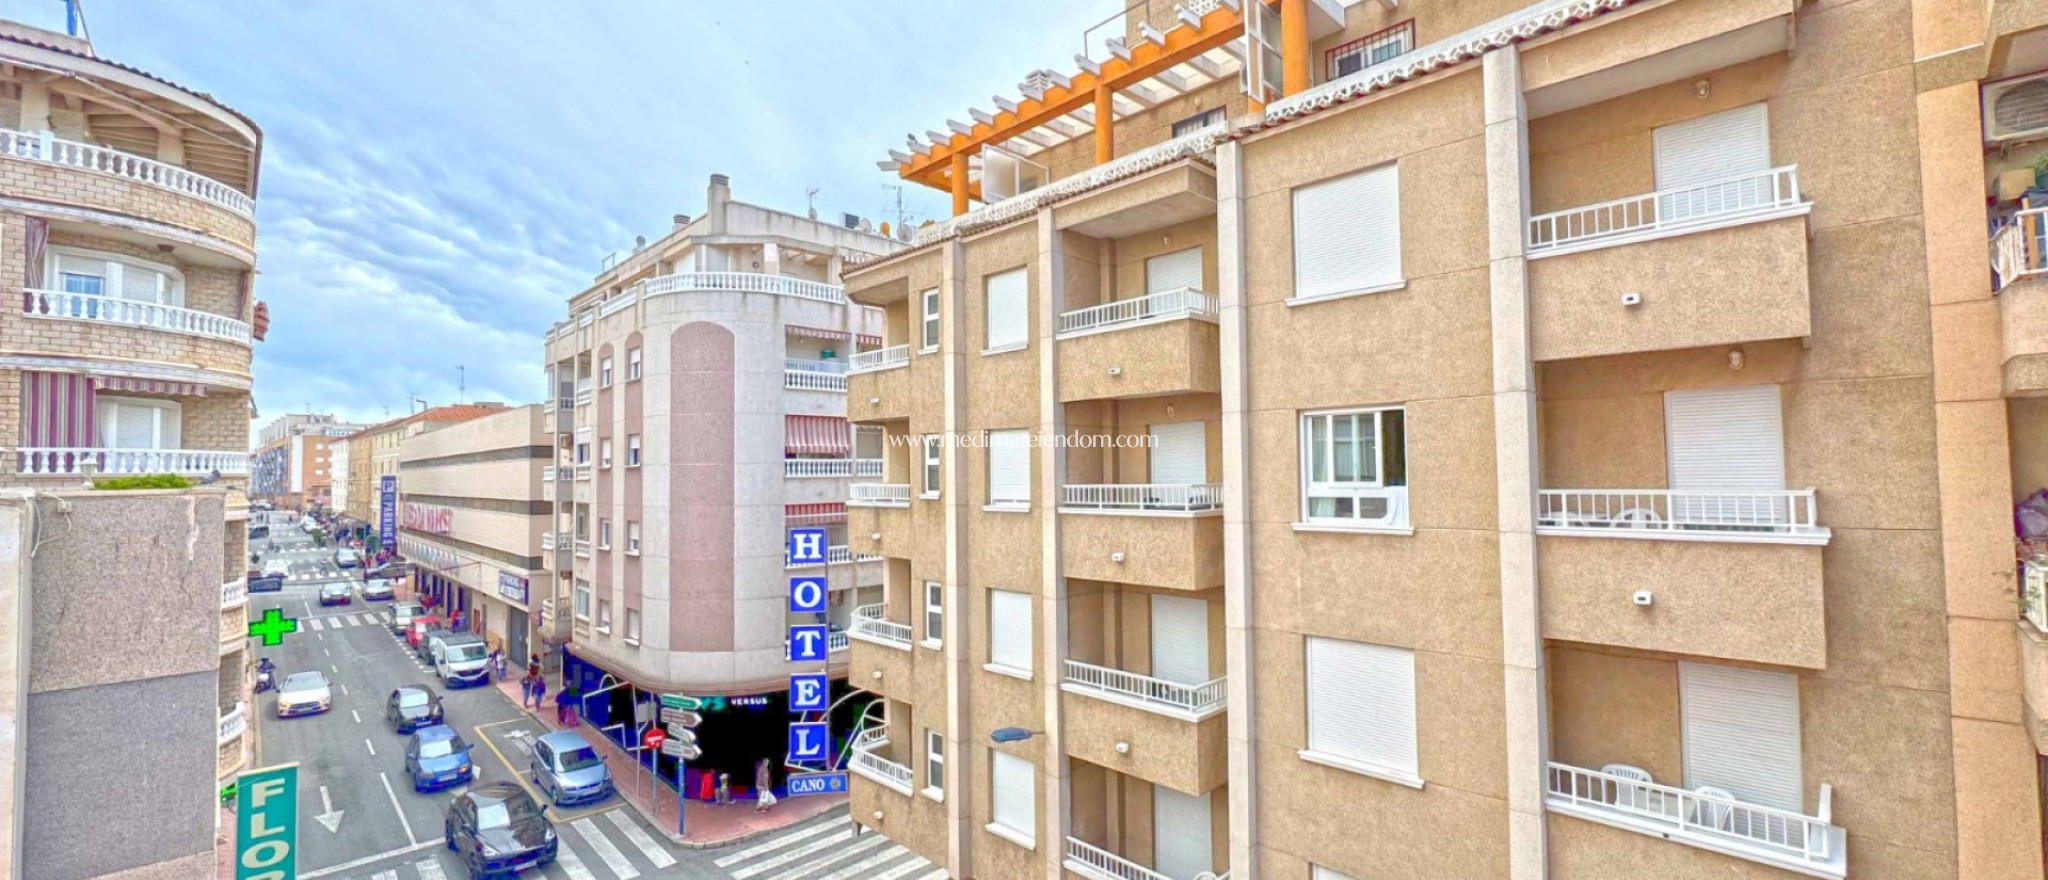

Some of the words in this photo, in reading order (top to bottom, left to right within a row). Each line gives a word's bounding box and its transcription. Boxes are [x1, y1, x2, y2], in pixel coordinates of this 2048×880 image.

[383, 502, 394, 538] PARKING
[793, 533, 822, 755] HOTEL
[731, 697, 768, 705] VERSUS
[791, 778, 826, 792] CANO
